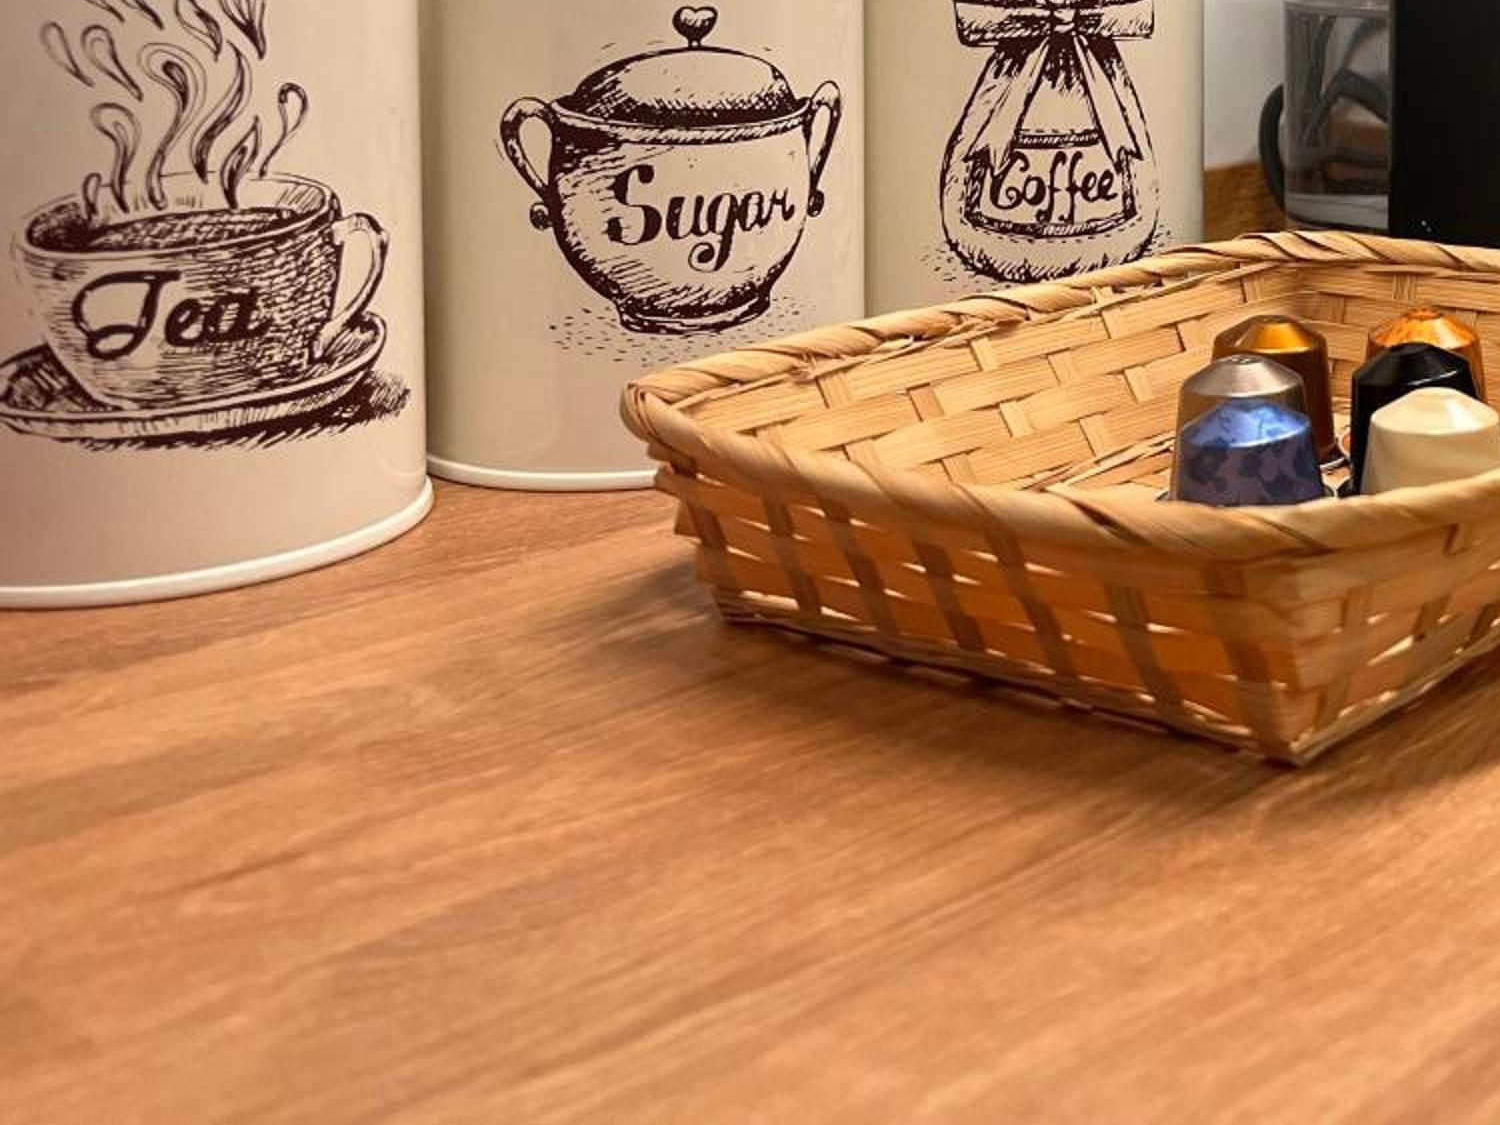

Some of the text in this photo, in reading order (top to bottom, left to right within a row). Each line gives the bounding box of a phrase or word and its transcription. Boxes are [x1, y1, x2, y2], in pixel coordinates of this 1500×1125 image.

[606, 164, 795, 273] Sugar
[990, 151, 1118, 224] Coffee
[72, 271, 272, 360] Tea
